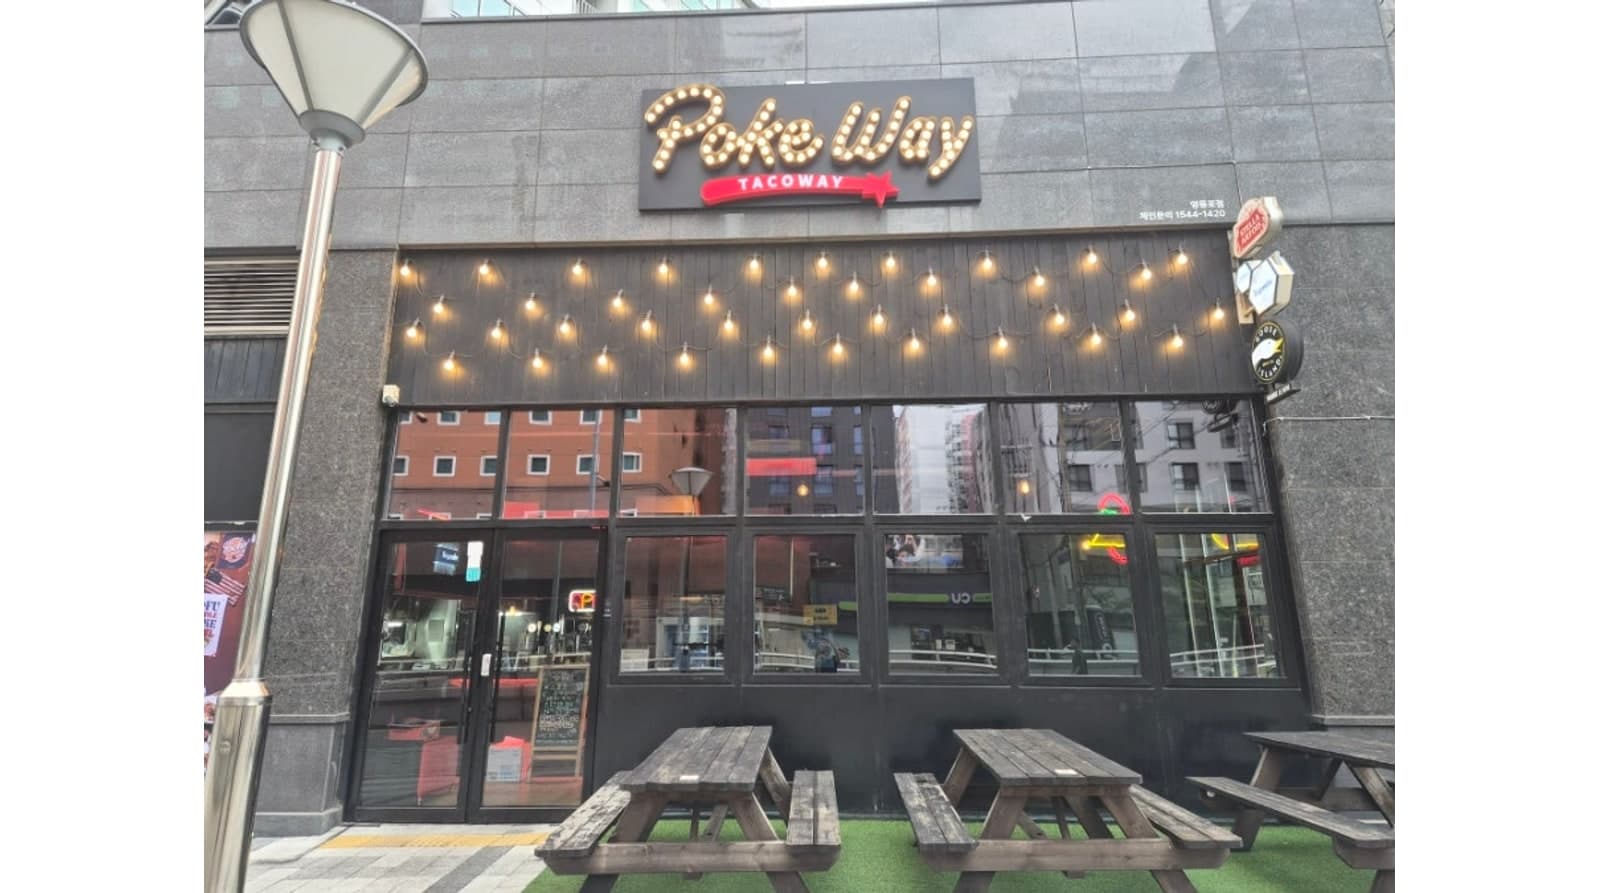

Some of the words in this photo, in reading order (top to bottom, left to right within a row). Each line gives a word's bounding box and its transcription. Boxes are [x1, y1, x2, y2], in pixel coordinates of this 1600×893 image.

[645, 84, 825, 174] Poke
[832, 96, 976, 181] Way
[738, 175, 845, 191] TACOWAY
[1175, 208, 1227, 219] 1544-1420
